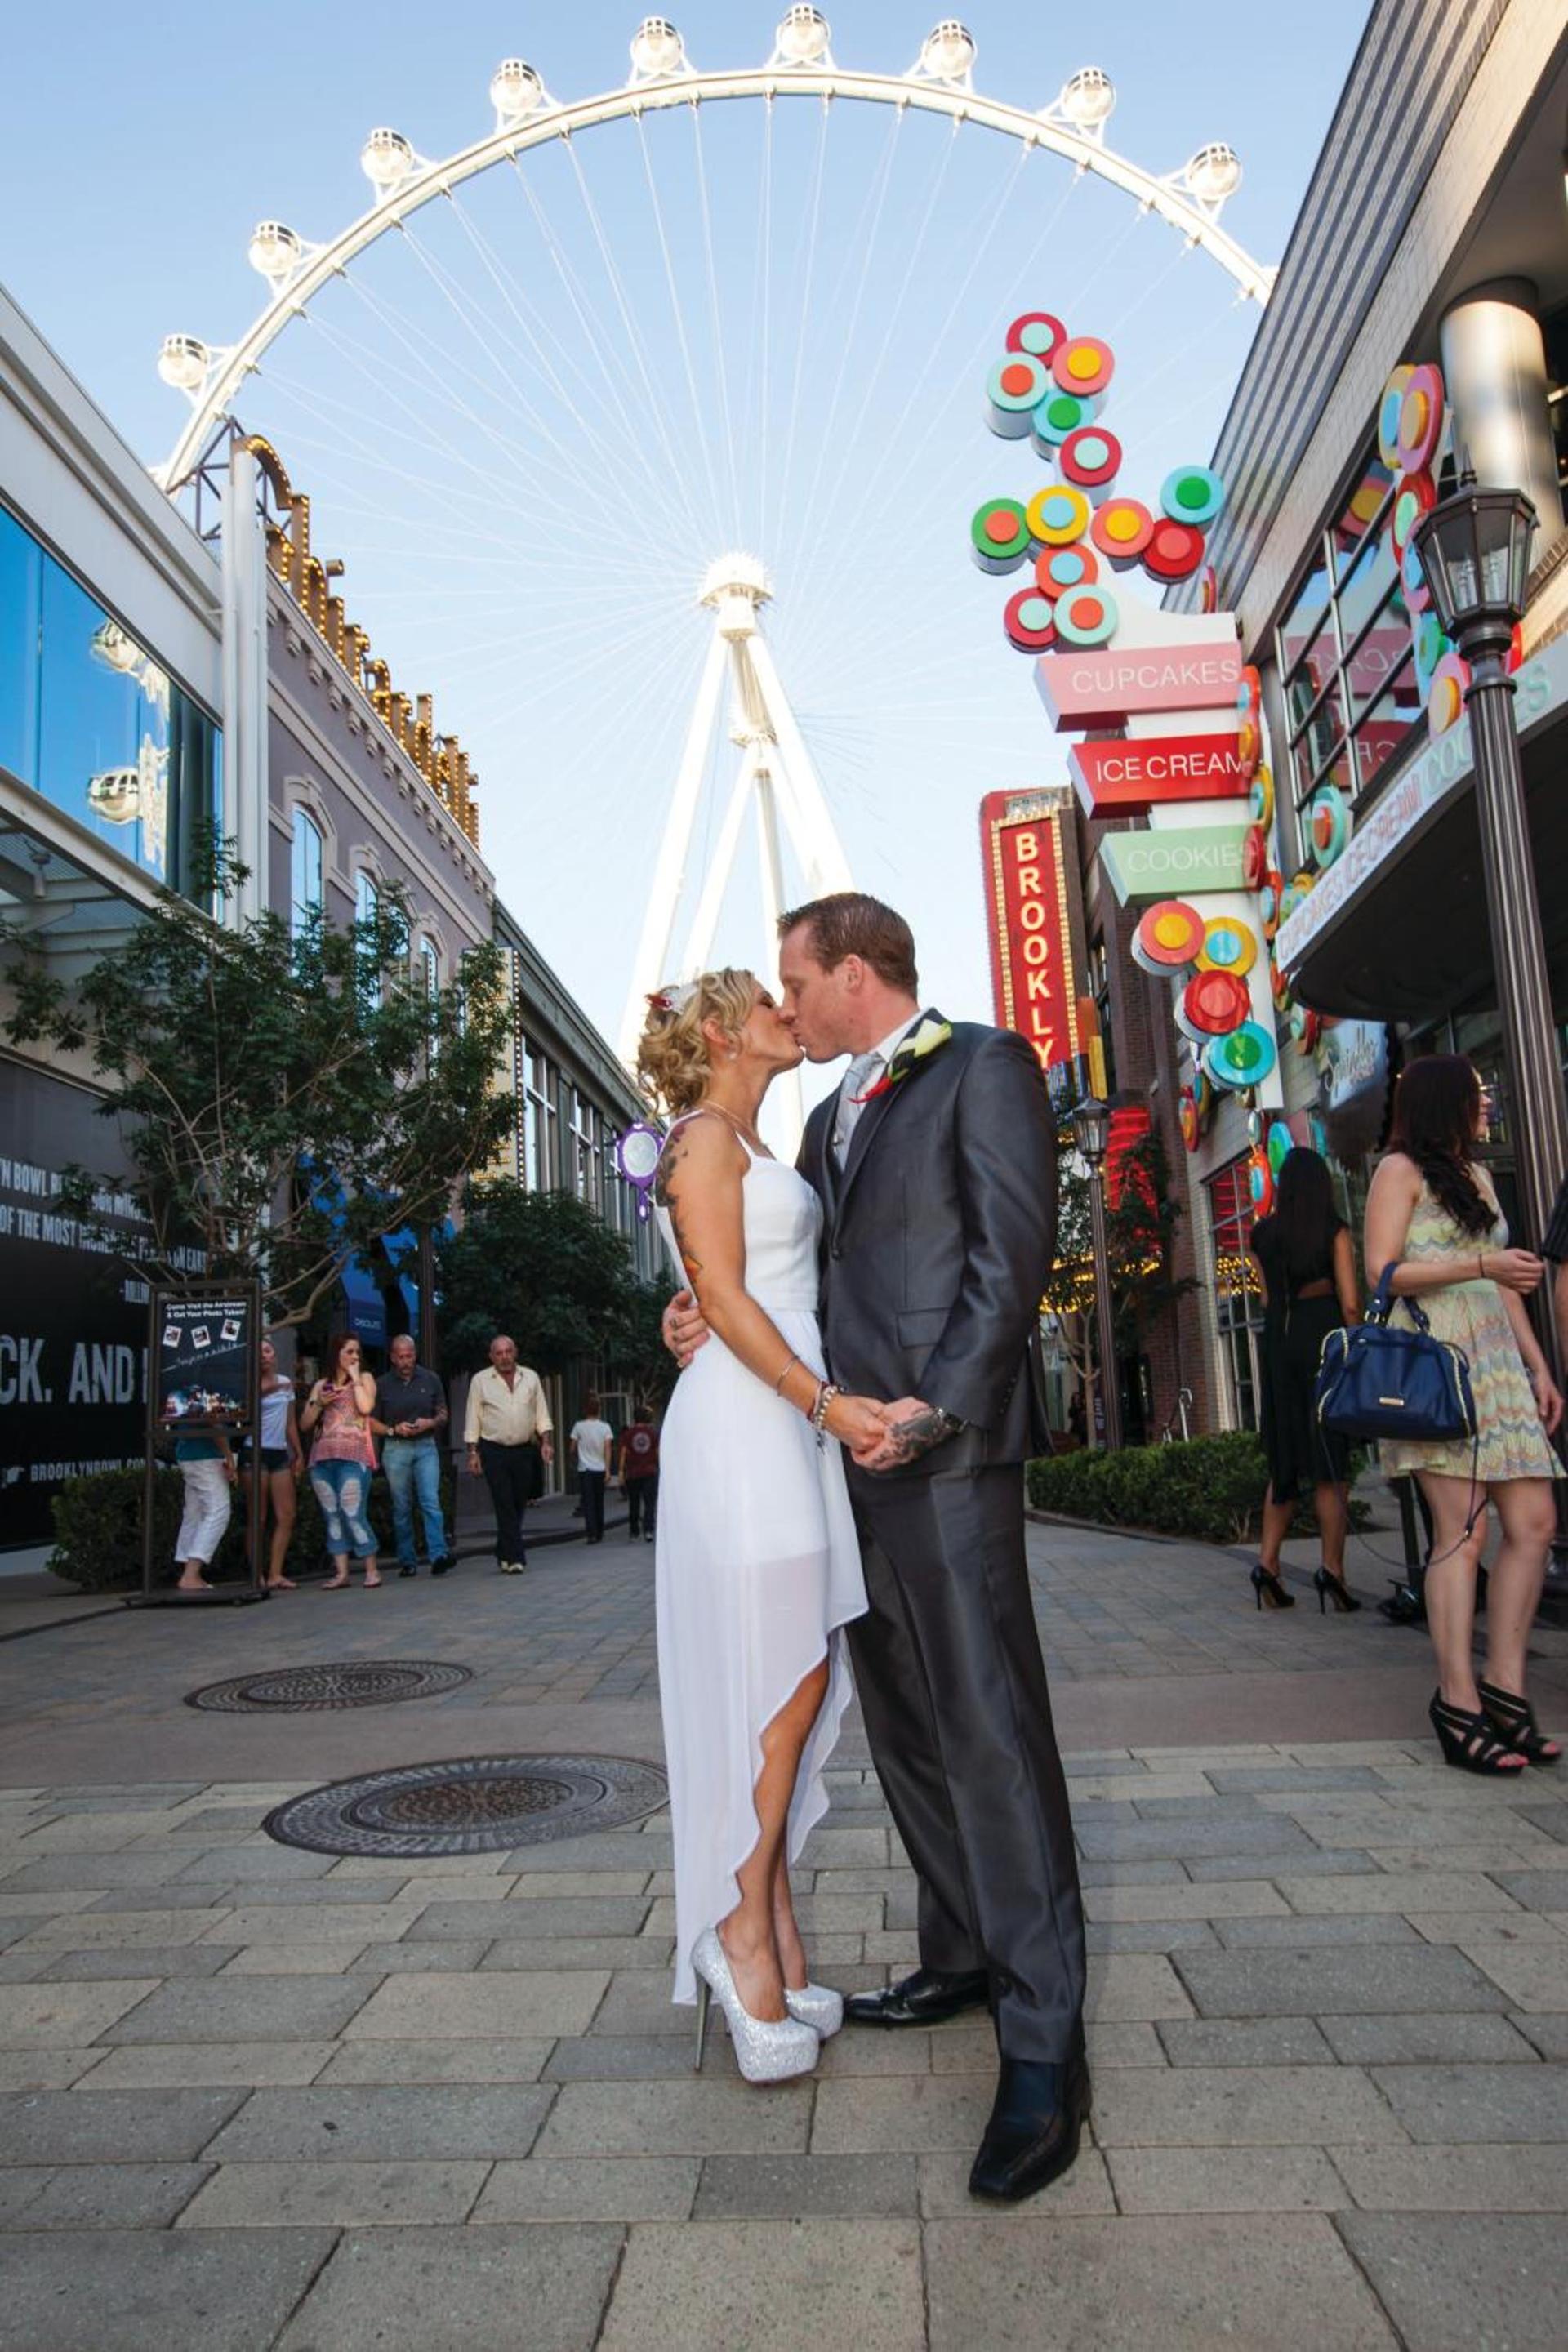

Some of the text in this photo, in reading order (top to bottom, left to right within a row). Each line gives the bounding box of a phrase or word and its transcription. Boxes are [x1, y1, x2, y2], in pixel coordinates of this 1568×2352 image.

[1071, 660, 1240, 693] CUPCAKES
[1097, 751, 1242, 784] ICE CREAM
[1128, 844, 1243, 873] COOKIE
[13, 1161, 49, 1197] BOWL
[0, 1205, 15, 1235] OF
[17, 1209, 40, 1241] THE
[42, 1214, 77, 1247] MOST
[68, 1342, 135, 1404] AND
